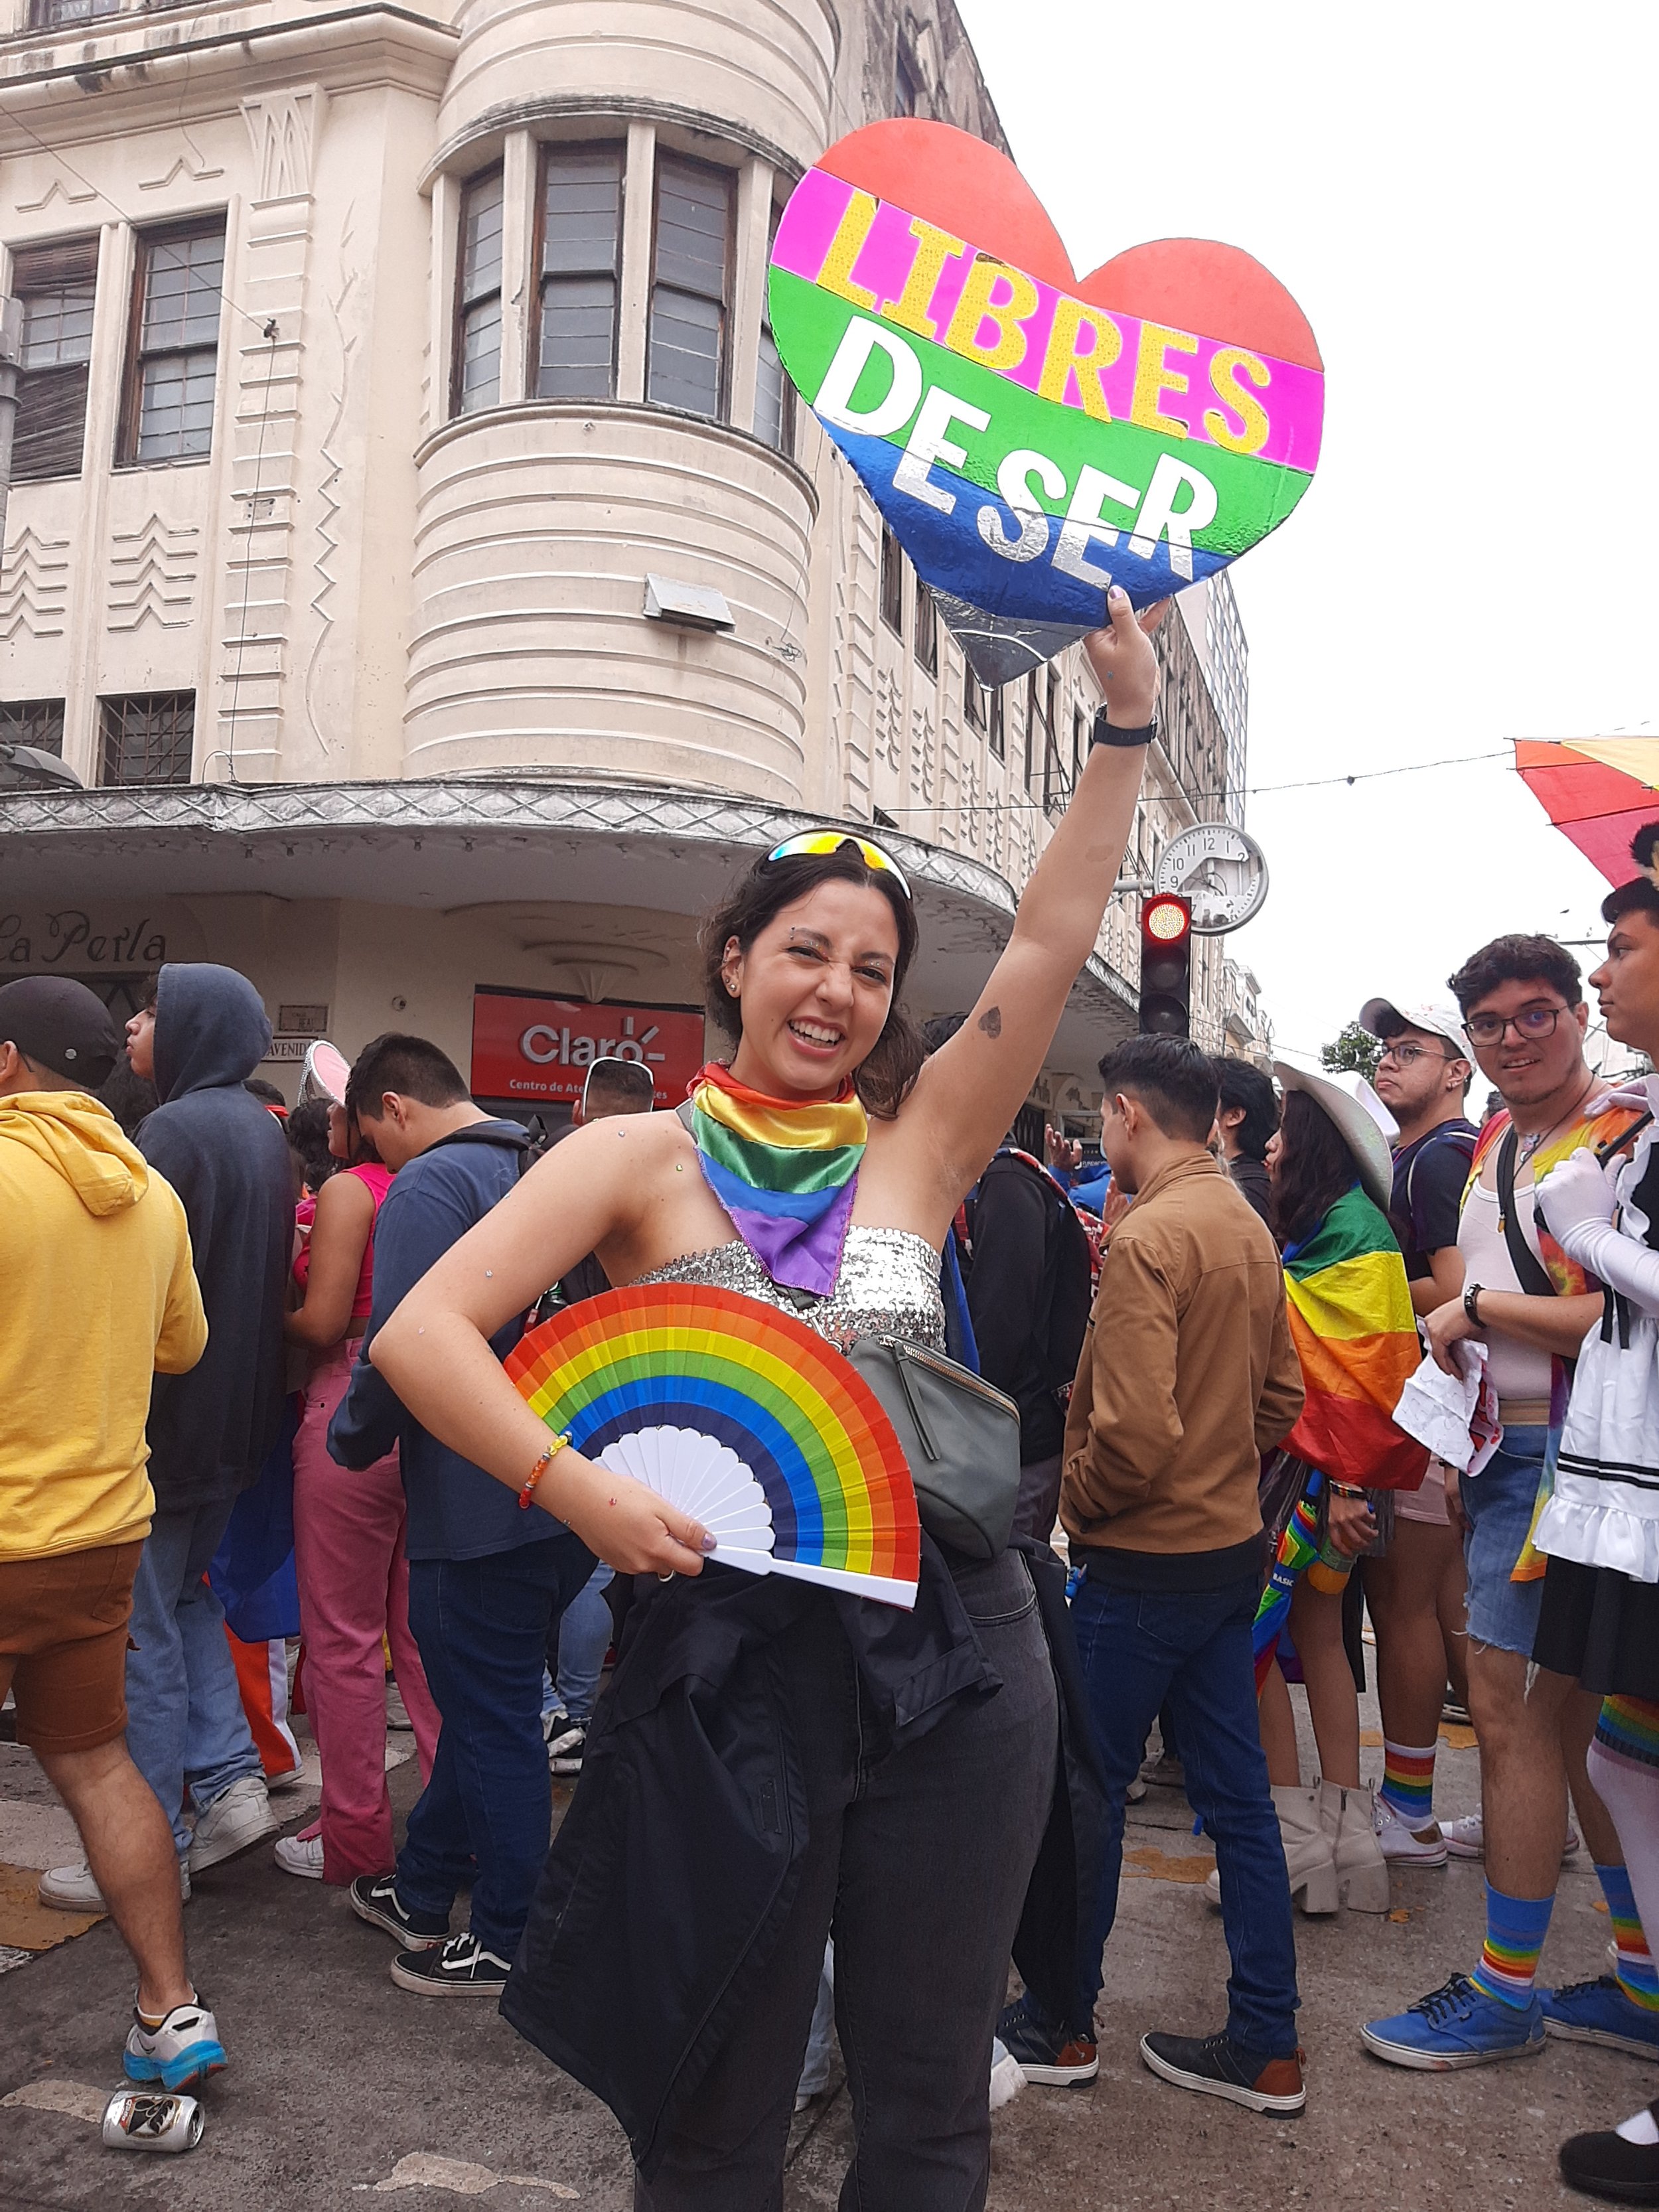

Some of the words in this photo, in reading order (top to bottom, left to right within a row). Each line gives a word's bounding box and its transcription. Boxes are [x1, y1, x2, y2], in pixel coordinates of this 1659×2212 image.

[816, 189, 1271, 455] LIBRES
[813, 315, 992, 516] DE
[977, 452, 1219, 592] SER
[1187, 844, 1195, 856] 11
[1204, 838, 1215, 851] 12
[1173, 857, 1184, 871] 10
[1170, 875, 1179, 888] 9
[41, 911, 165, 962] Perla
[267, 1043, 311, 1057] AVENID
[521, 1025, 643, 1066] Claro
[510, 1079, 547, 1091] Centro
[549, 1081, 563, 1092] de
